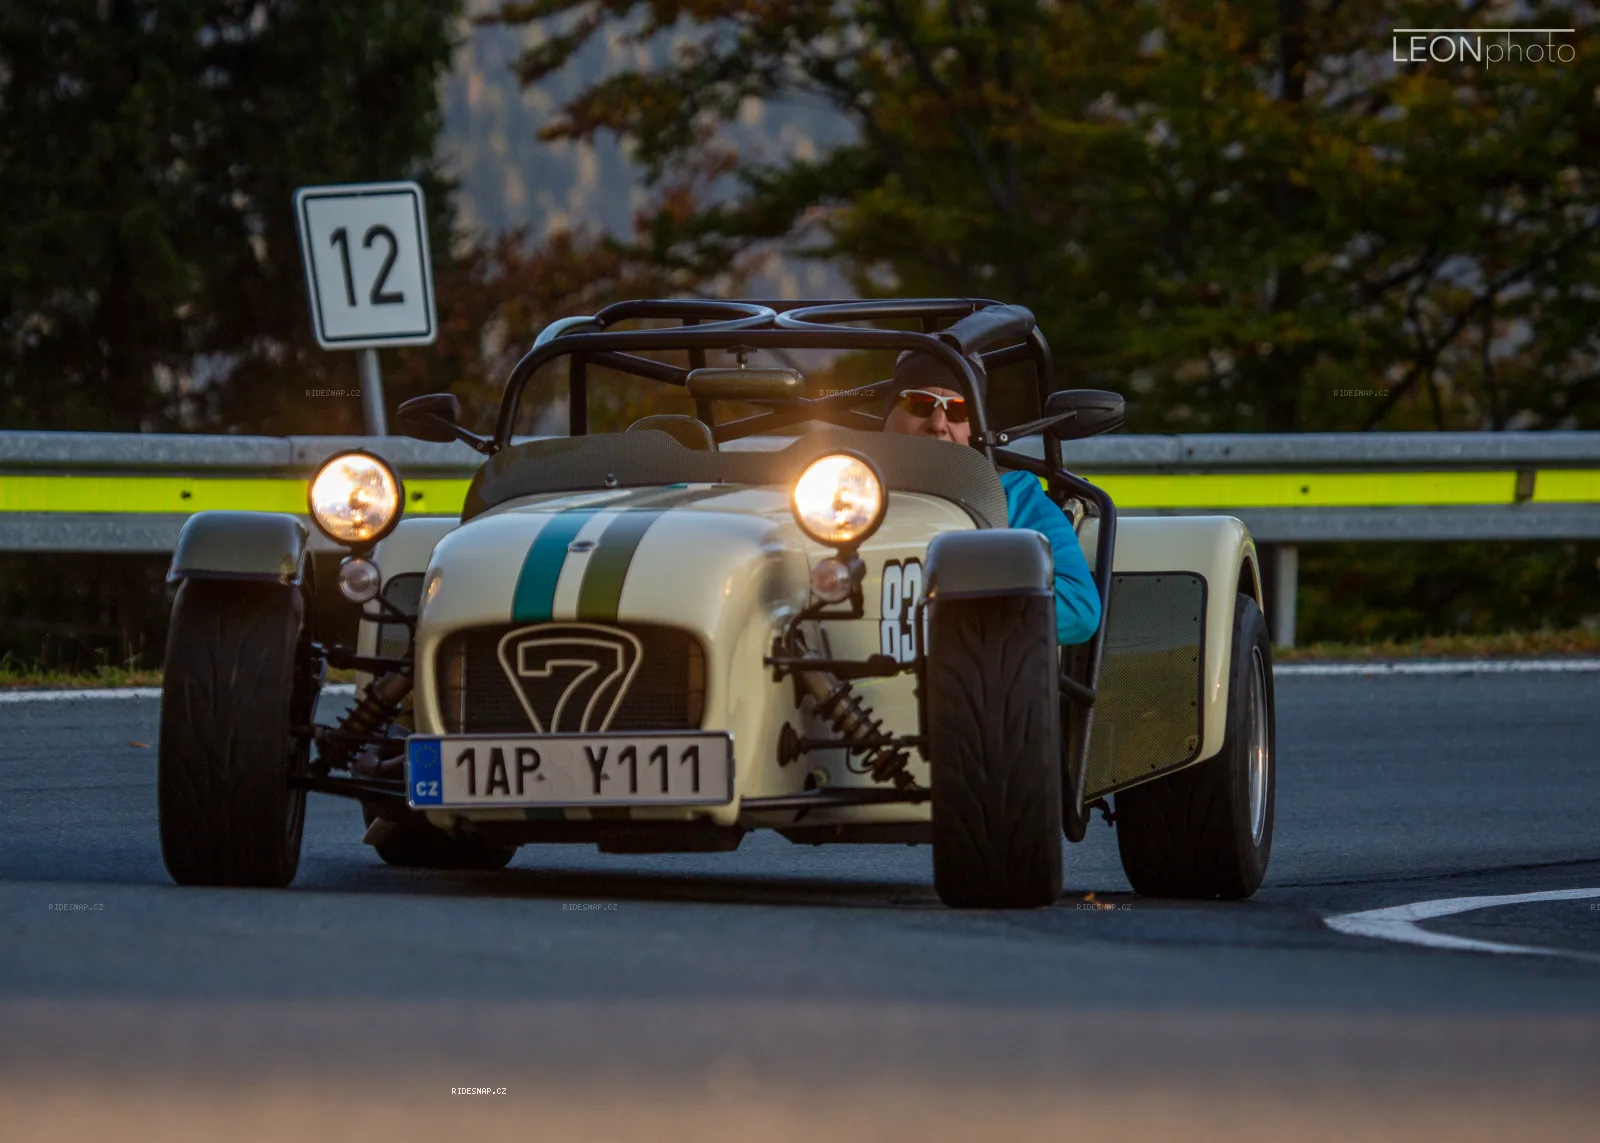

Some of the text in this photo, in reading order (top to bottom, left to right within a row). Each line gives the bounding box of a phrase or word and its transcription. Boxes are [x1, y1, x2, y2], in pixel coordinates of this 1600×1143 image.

[329, 224, 405, 307] 12
[880, 557, 929, 665] 83
[517, 636, 625, 733] 7
[415, 780, 440, 797] CZ
[455, 744, 701, 796] 1AP Y111
